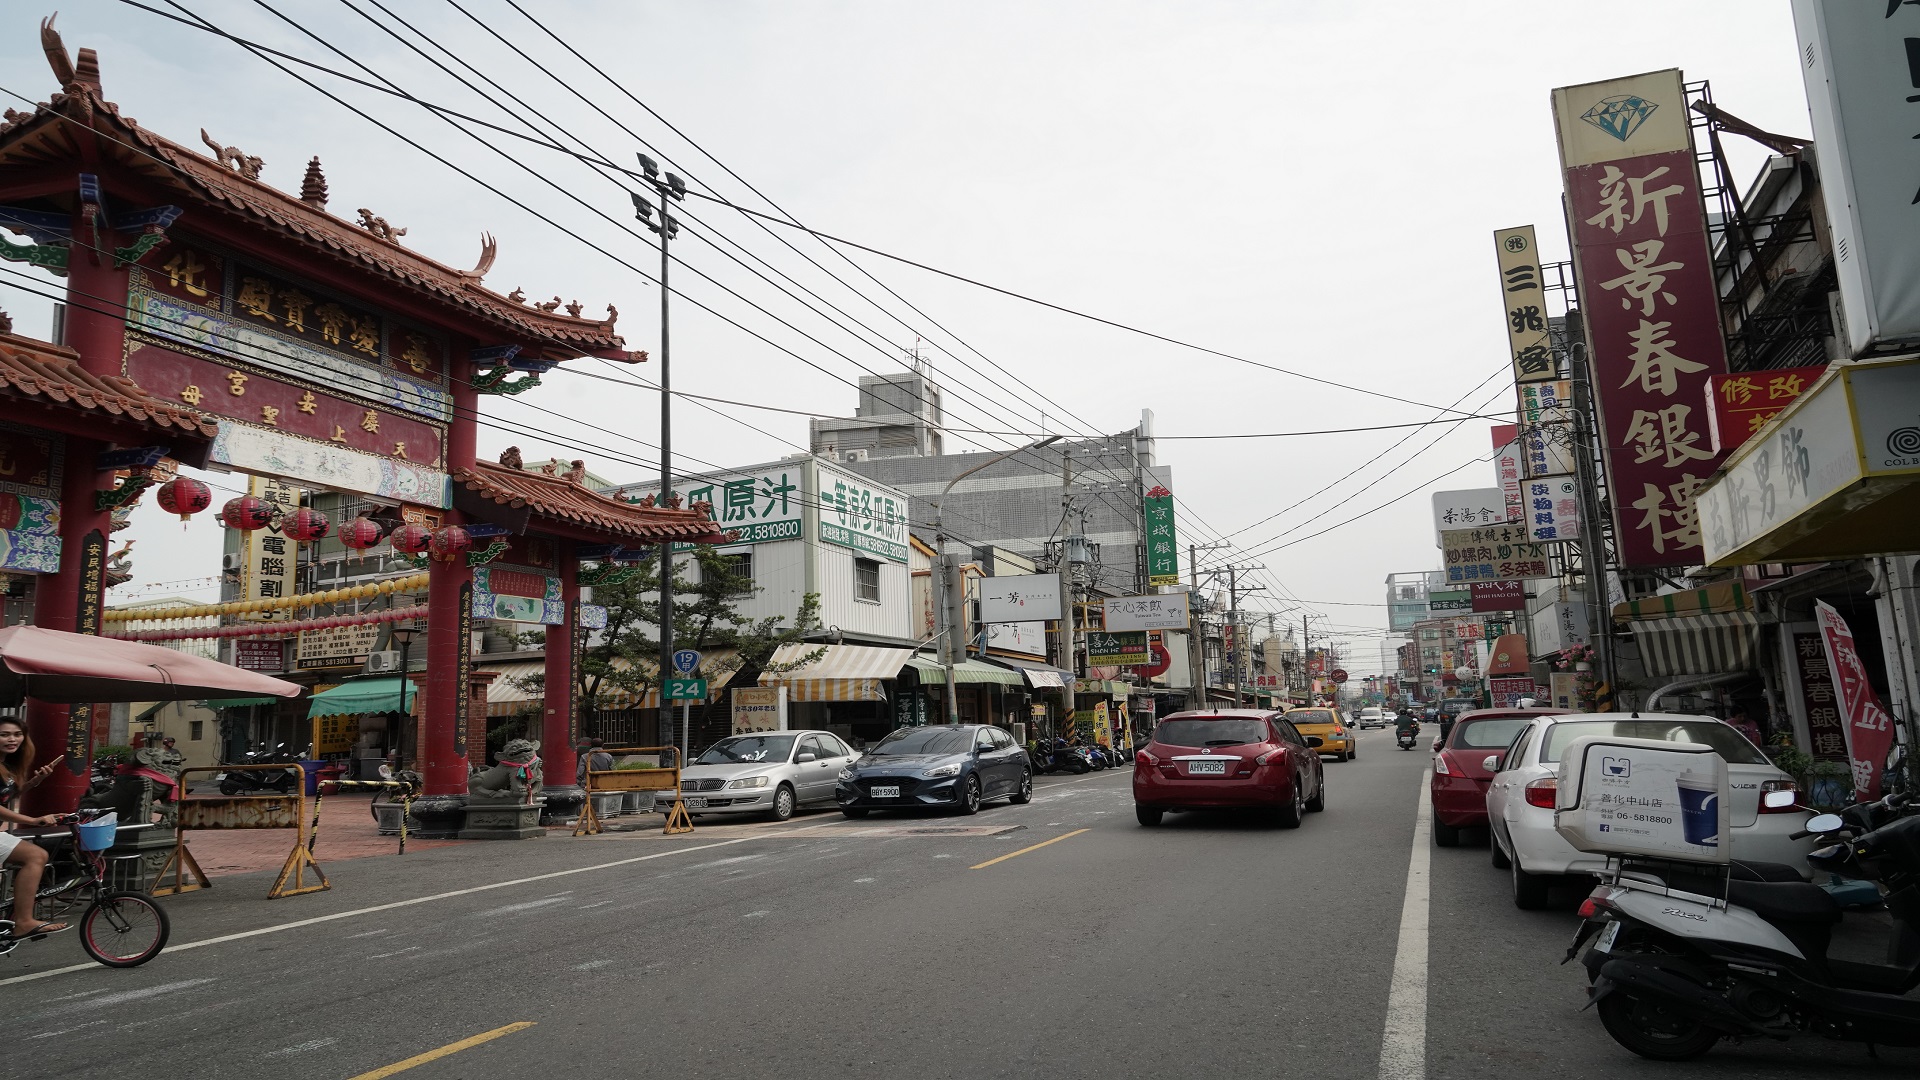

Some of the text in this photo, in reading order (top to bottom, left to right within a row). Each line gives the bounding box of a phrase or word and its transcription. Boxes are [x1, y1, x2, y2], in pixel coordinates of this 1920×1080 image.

[163, 251, 207, 297] 化
[1585, 166, 1715, 555] 新景春銀樓
[1721, 374, 1804, 404] 修改
[1884, 458, 1910, 467] COL
[1443, 507, 1494, 524] 茶湯會
[1152, 507, 1171, 571] 京城銀行
[990, 592, 1019, 604] 一芳
[1110, 600, 1162, 613] 天心茶飲
[1562, 607, 1578, 642] 茶湯會
[680, 653, 693, 663] 19
[682, 663, 691, 671] 甲
[672, 683, 699, 696] 24
[1800, 637, 1843, 753] 新景春銀樓
[1189, 763, 1224, 772] AHV-5082
[1601, 793, 1662, 808] 善化中山店
[1617, 812, 1672, 825] 06-5818800
